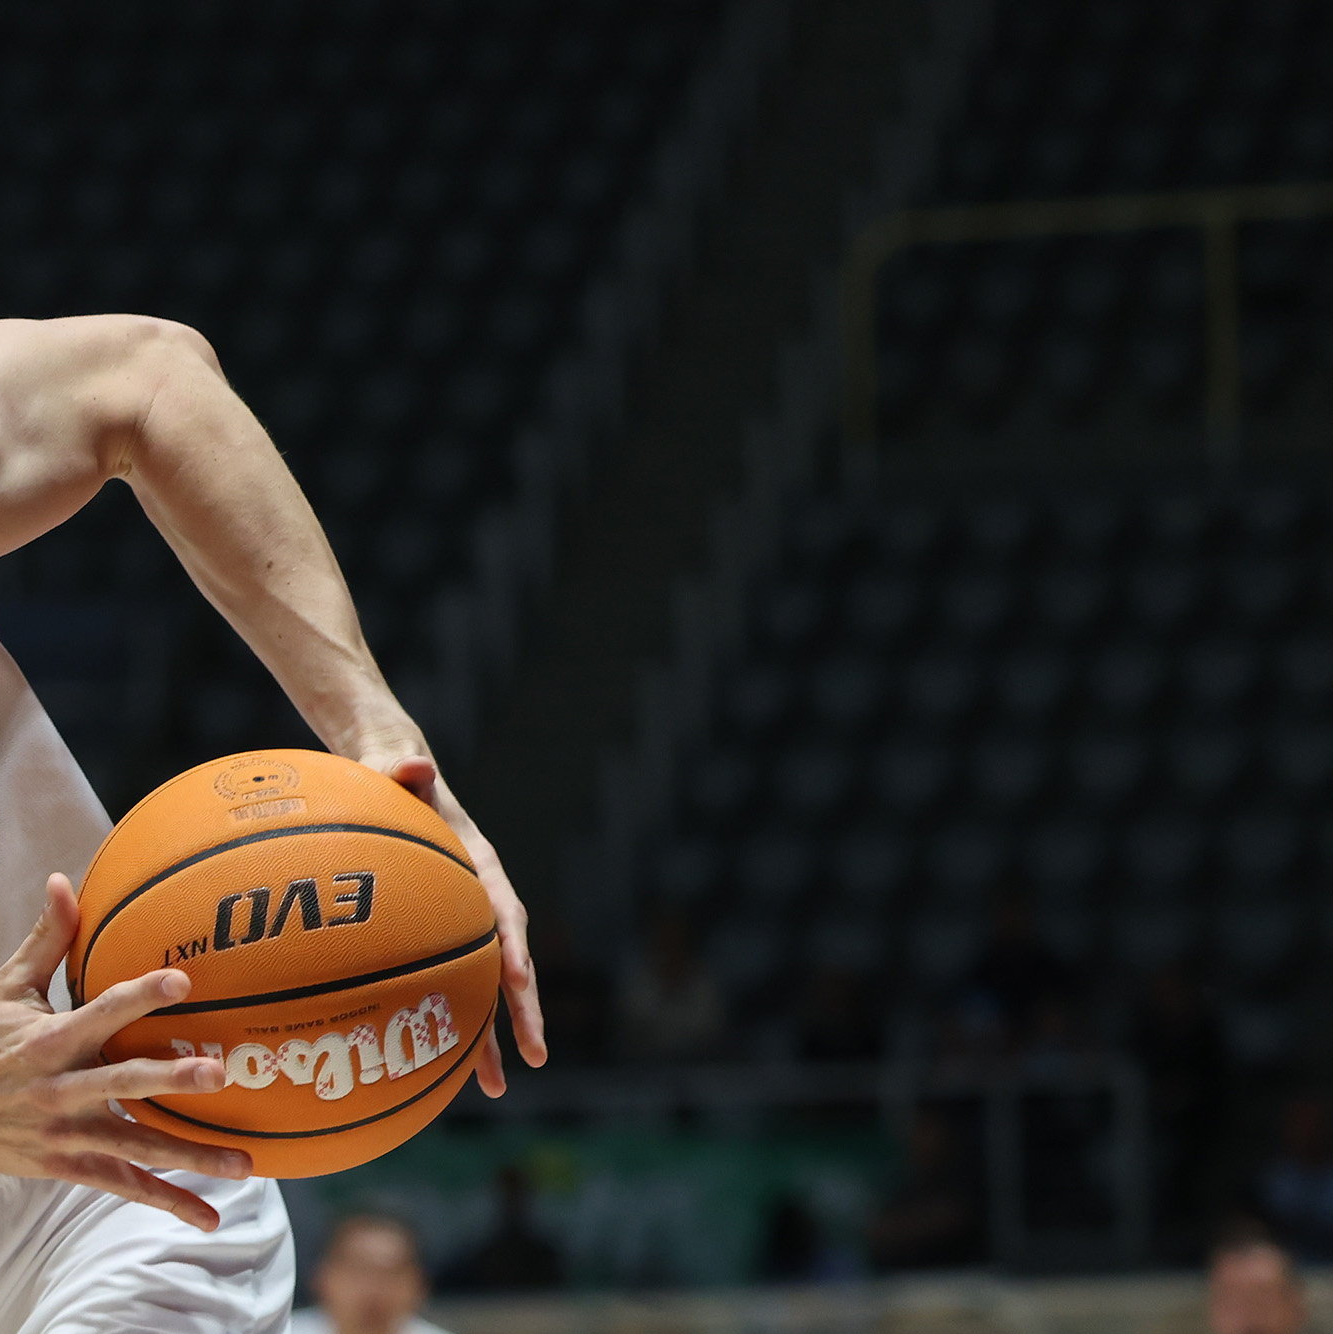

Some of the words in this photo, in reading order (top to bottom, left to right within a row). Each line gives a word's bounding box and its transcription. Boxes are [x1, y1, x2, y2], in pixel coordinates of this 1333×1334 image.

[212, 870, 376, 951] EVO
[162, 935, 208, 969] NXT
[285, 1019, 325, 1032] GAME
